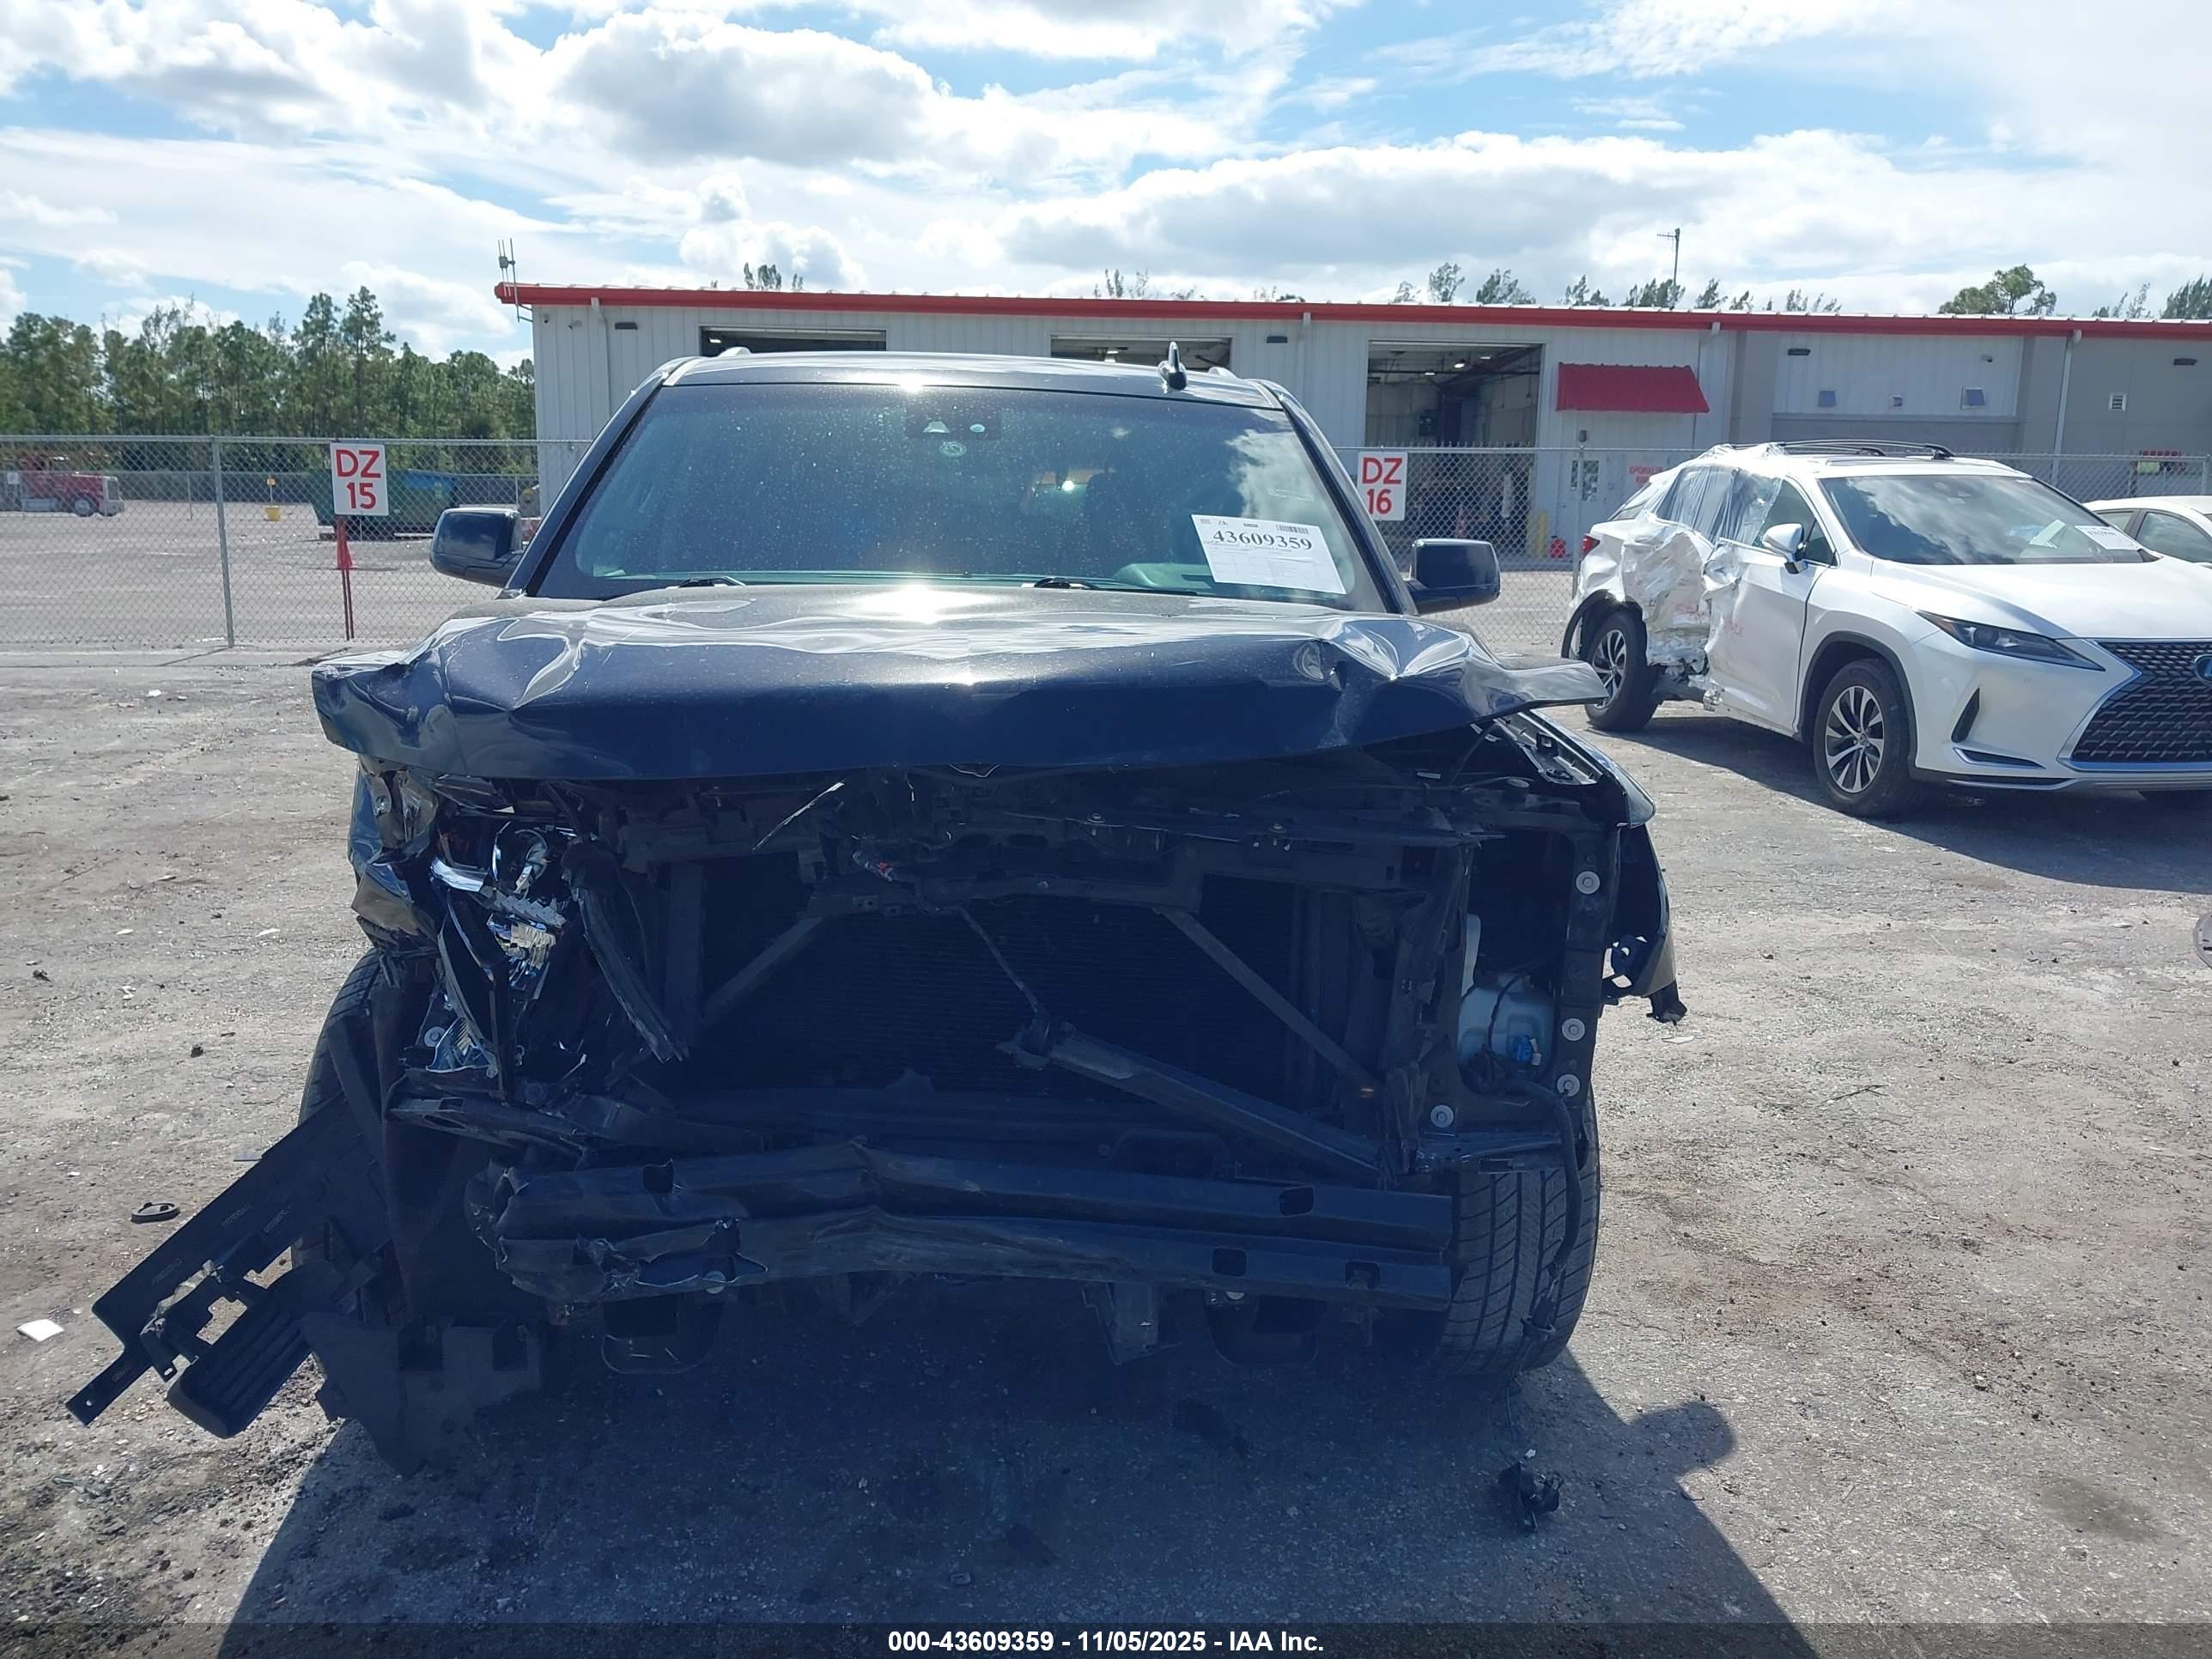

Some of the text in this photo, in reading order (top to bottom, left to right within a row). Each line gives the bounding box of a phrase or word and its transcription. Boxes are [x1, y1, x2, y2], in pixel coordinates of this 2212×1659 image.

[336, 449, 381, 478] DZ
[1362, 457, 1402, 485] DZ
[346, 482, 377, 510] 15
[1366, 488, 1393, 515] 16
[1212, 529, 1313, 551] 43609359
